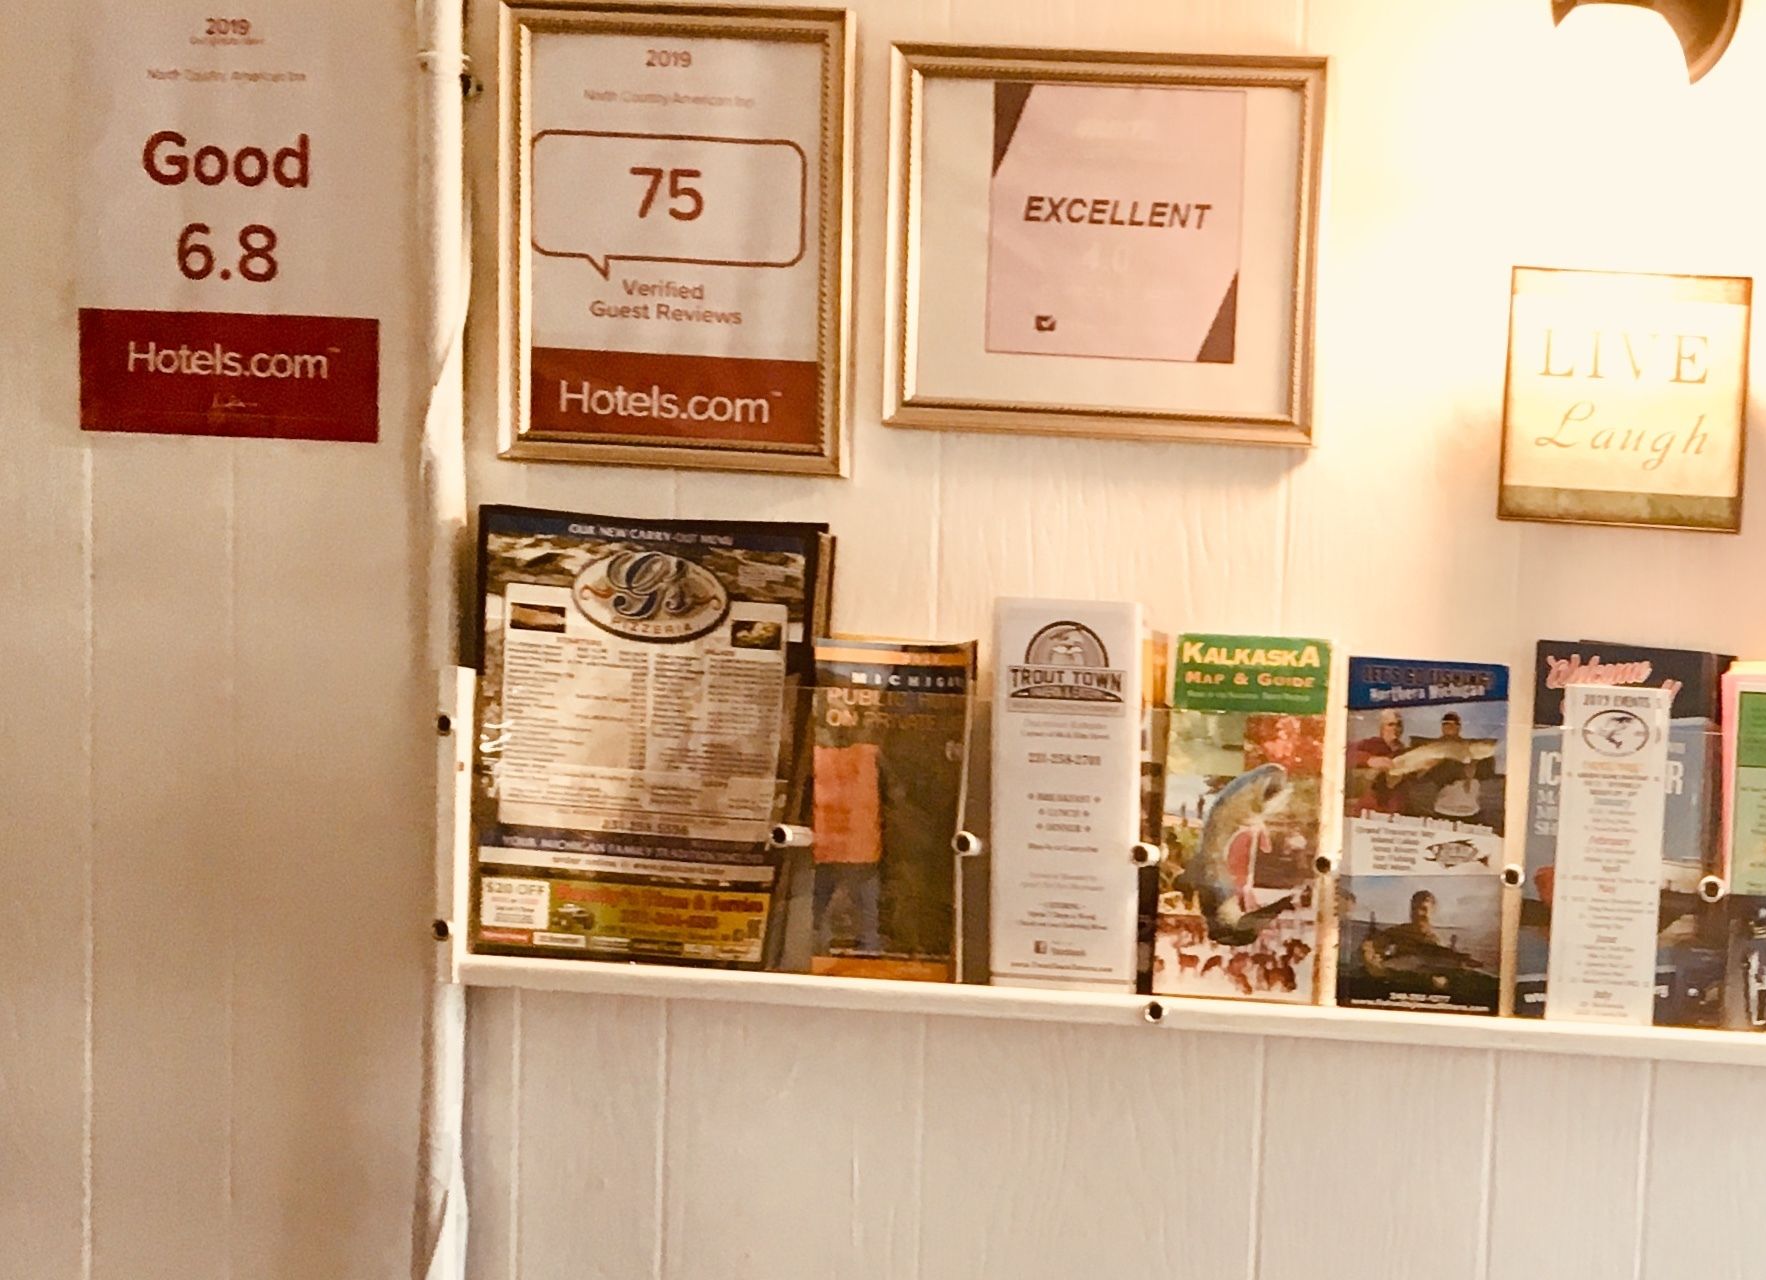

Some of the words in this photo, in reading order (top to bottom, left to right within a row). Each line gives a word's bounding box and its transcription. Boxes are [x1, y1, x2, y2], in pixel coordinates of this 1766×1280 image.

[205, 17, 251, 36] 2019
[644, 49, 693, 68] 2019
[141, 130, 310, 188] Good
[628, 166, 705, 222] 75
[1023, 195, 1212, 231] EXCELLENT
[177, 222, 279, 283] 6.8
[621, 278, 705, 301] Verified
[588, 300, 651, 321] Guest
[655, 303, 743, 326] Reviews
[127, 340, 329, 380] Hotels.com
[1538, 328, 1709, 385] LIVE
[559, 379, 771, 424] Hotels.com
[1535, 399, 1709, 471] Laugh
[567, 522, 597, 536] OUR
[598, 524, 627, 538] NEW
[610, 616, 694, 638] PIZZERIA
[1182, 640, 1321, 669] KALKASKA
[1010, 667, 1066, 689] TROUT
[1071, 671, 1123, 693] TOWN
[1232, 671, 1249, 685] &
